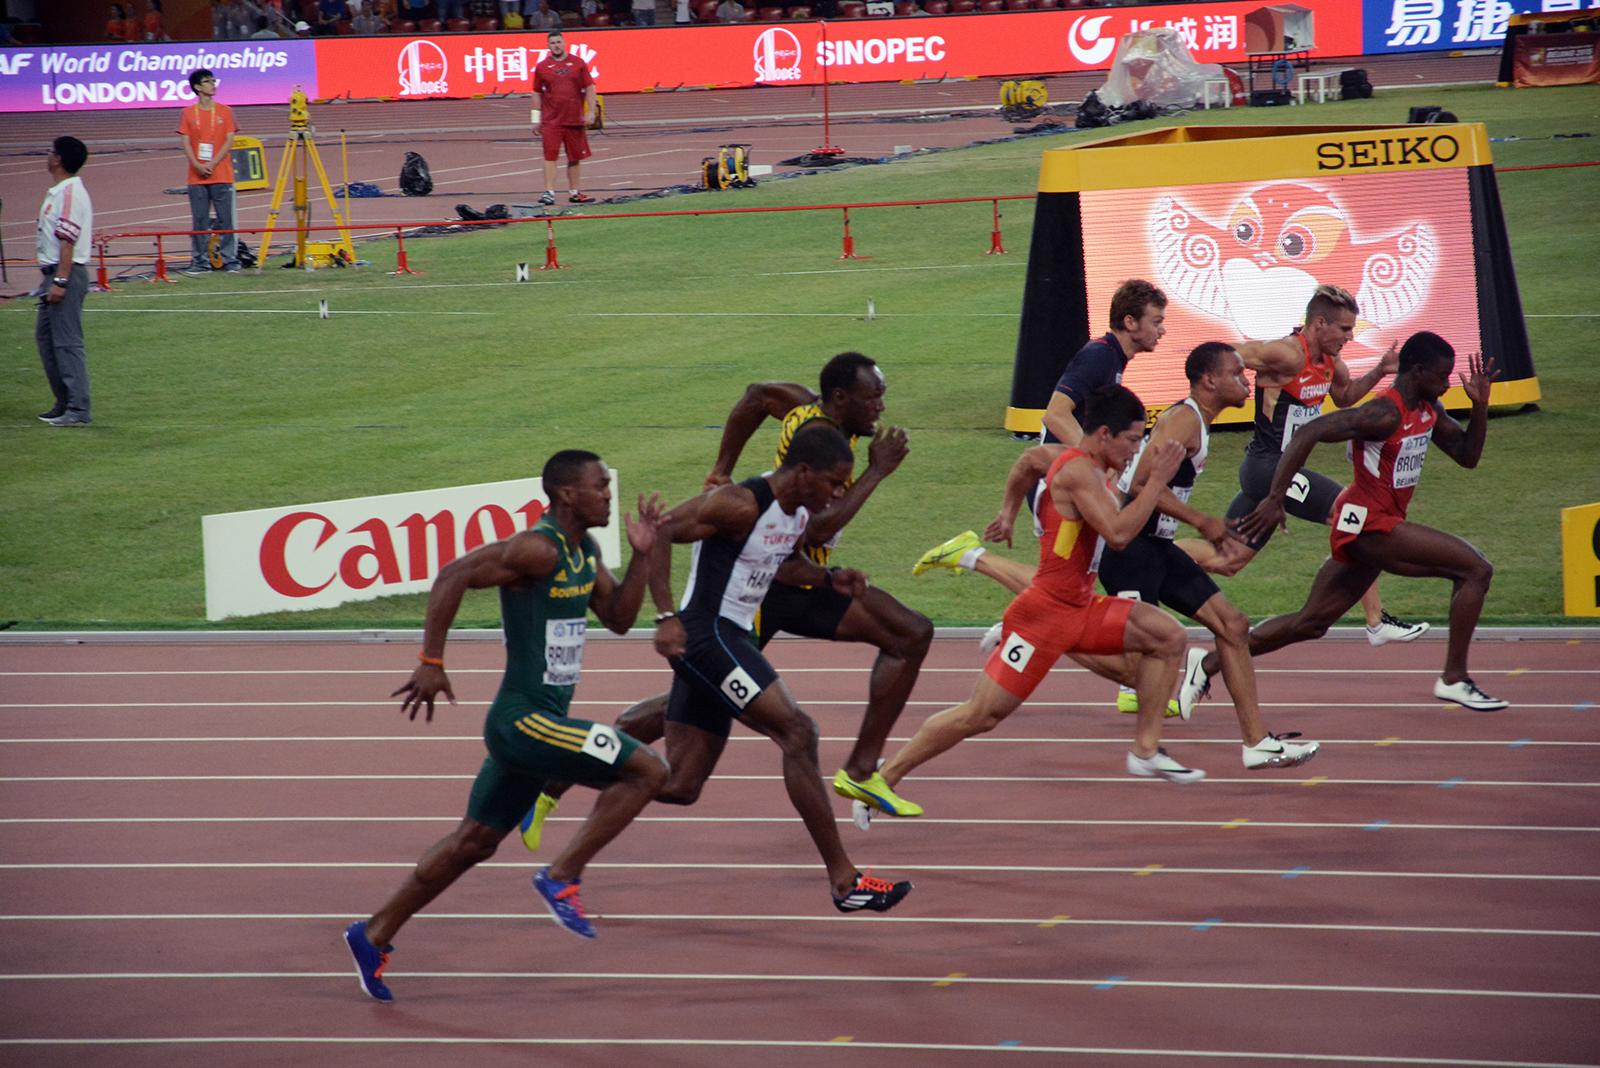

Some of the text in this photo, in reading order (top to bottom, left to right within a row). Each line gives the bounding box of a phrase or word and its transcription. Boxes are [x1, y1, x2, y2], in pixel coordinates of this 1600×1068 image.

[41, 51, 112, 74] World
[117, 47, 289, 75] Championships
[816, 36, 946, 66] SINOPEC
[41, 81, 158, 105] LONDON
[1316, 134, 1459, 170] SEIKO
[1343, 511, 1361, 526] 4
[1008, 644, 1025, 663] 6
[729, 679, 748, 699] 8
[594, 733, 616, 751] 9
